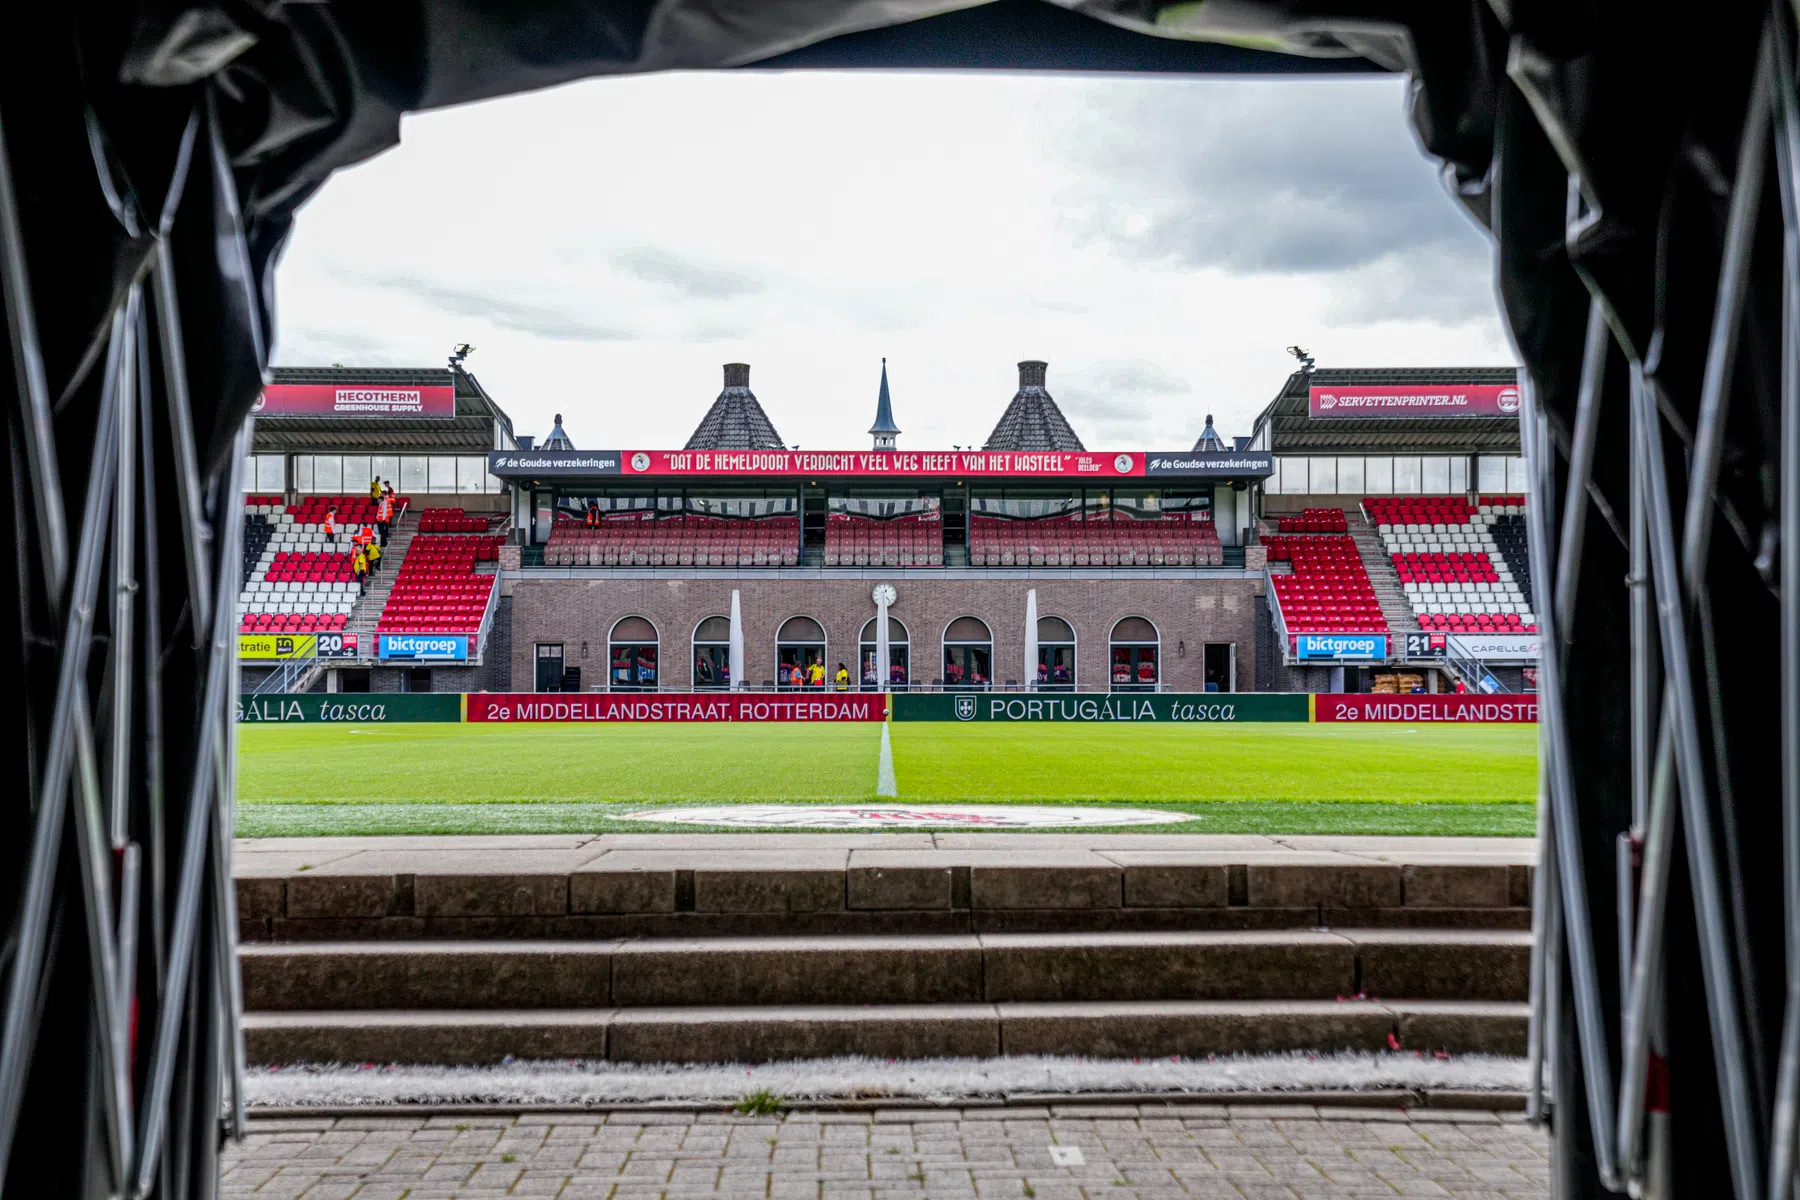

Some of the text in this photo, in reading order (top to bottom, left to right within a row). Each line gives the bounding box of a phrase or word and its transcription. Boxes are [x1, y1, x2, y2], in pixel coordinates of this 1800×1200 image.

[338, 392, 418, 402] HECOTHERM
[1338, 394, 1468, 407] SERVETTENPRINTER.NL
[334, 404, 423, 412] GREENHOUSE SUPPLY
[507, 458, 615, 469] de Goudse verzekeringen
[695, 454, 711, 471] DE
[714, 454, 789, 471] HEMELPOORT
[795, 454, 855, 471] VERDACHT
[860, 454, 889, 471] VEEL
[893, 454, 919, 471] WEG
[922, 454, 957, 471] HEEFT
[962, 454, 985, 471] VAN
[989, 454, 1011, 471] HET
[1161, 458, 1268, 471] de Goudse verzekeringen
[319, 635, 342, 651] 20
[388, 637, 456, 654] bictgroep
[1307, 637, 1375, 653] bictgroep
[1408, 635, 1429, 651] 21
[1471, 645, 1527, 653] CAPELLE
[320, 701, 386, 721] tasca
[487, 703, 869, 722] 2e MIDDELLANDSTRAAT, ROTTERDAM
[990, 693, 1235, 721] PORTUGÁLIA tasca
[1335, 703, 1359, 720] 2e
